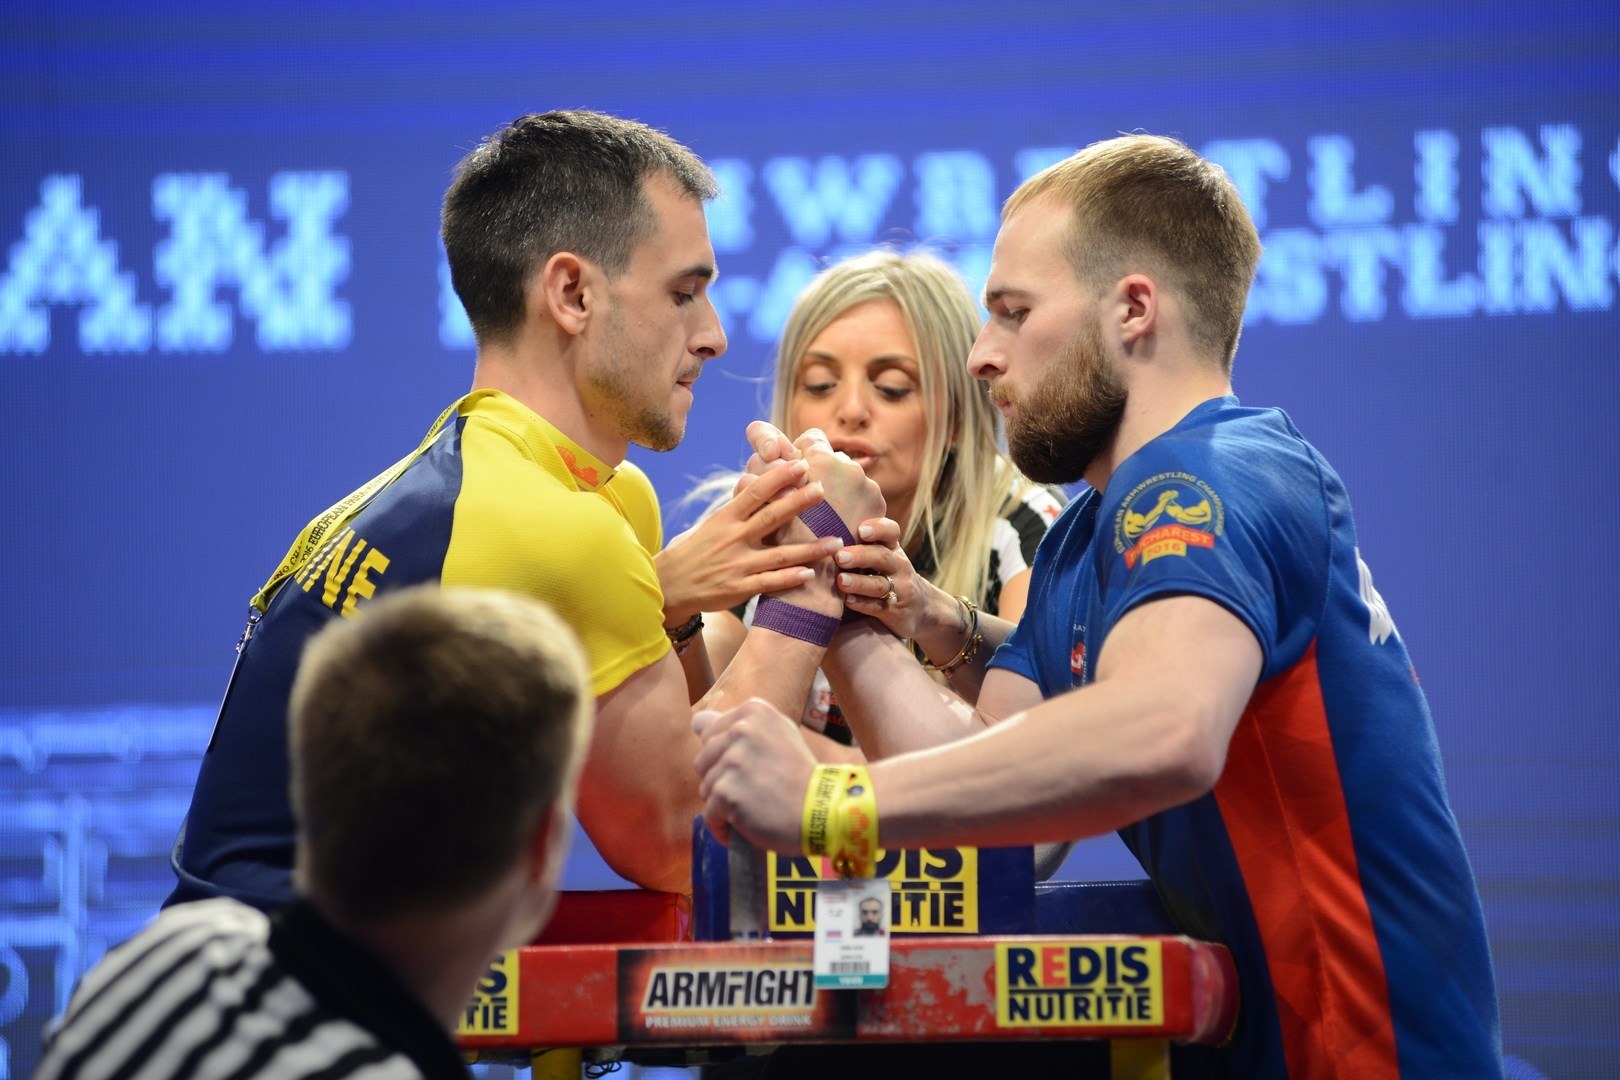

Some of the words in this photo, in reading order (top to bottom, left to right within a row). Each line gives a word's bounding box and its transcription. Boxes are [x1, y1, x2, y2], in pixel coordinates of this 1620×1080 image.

[1129, 526, 1212, 561] BCHAREST
[1007, 946, 1150, 988] REDIS
[648, 970, 814, 1008] ARMFIGHT
[1008, 991, 1152, 1021] NUTRITIE
[645, 1016, 709, 1028] PREMIUM
[714, 1015, 766, 1027] ENERGY
[768, 1014, 812, 1026] DRINK
